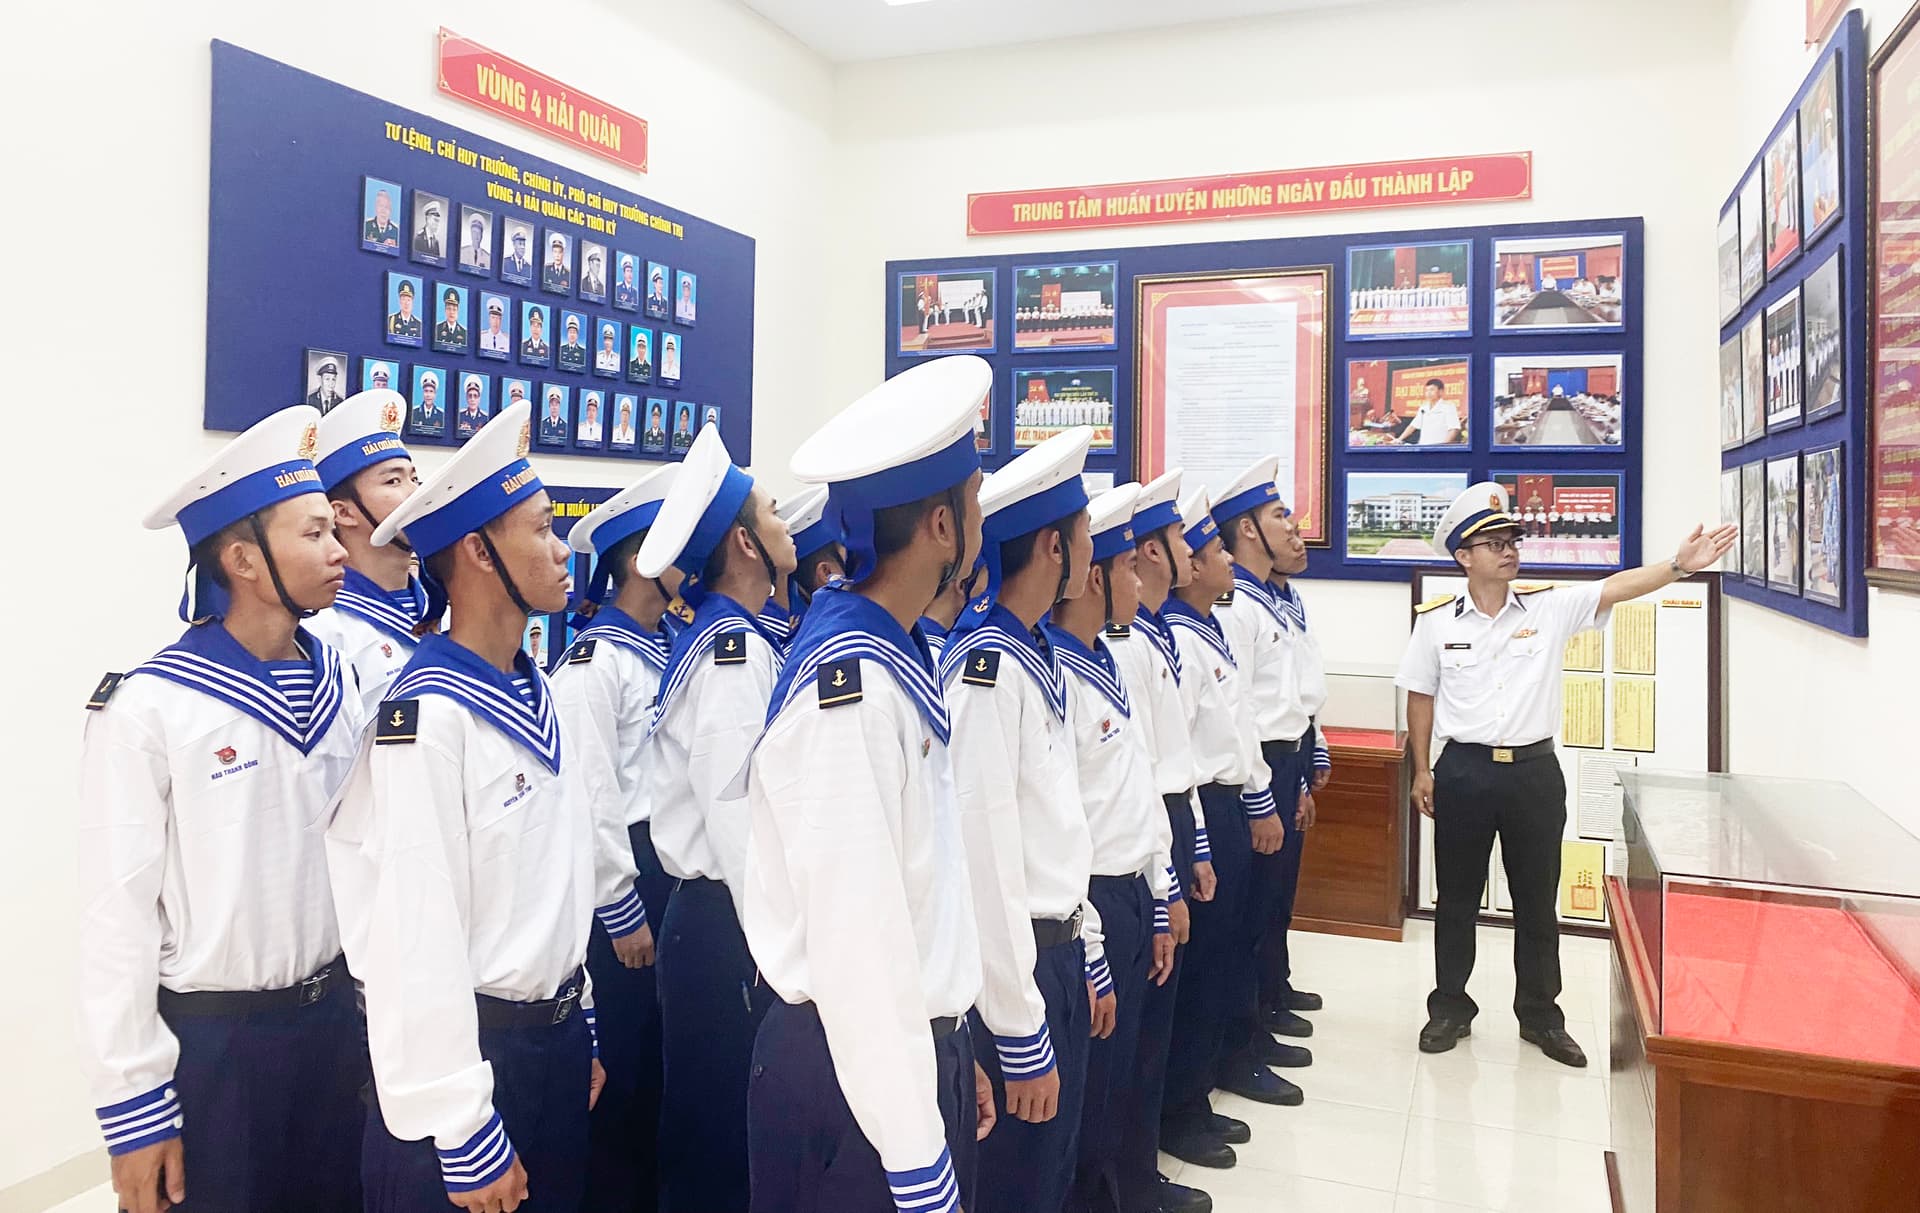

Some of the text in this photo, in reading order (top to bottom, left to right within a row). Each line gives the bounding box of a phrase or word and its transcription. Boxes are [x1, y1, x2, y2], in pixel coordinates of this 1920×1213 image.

[476, 63, 621, 152] VÙNG 4 HẢI QUÂN
[385, 121, 402, 141] TƯ
[402, 127, 434, 155] LỆNH,
[437, 139, 456, 160] CHỈ
[457, 147, 478, 168] HUY
[480, 155, 521, 184] TRƯỞNG,
[523, 171, 551, 193] CHÍNH
[552, 175, 567, 200] ỦY,
[568, 185, 585, 205] PHÓ
[587, 192, 601, 209] CHỈ
[603, 198, 618, 215] HUY
[620, 203, 649, 226] TRƯỞNG
[650, 215, 671, 234] CHÍNH
[486, 181, 513, 204] VÙNG
[515, 192, 522, 206] 4
[524, 192, 540, 212] HẢI
[541, 201, 566, 221] QUÂN
[567, 207, 585, 226] CÁC
[586, 214, 604, 233] THỜI
[1012, 167, 1475, 222] TRUNG TÂM HUẤN LUYỆN NHỮNG NGÀY ĐẦU THÀNH LẬP
